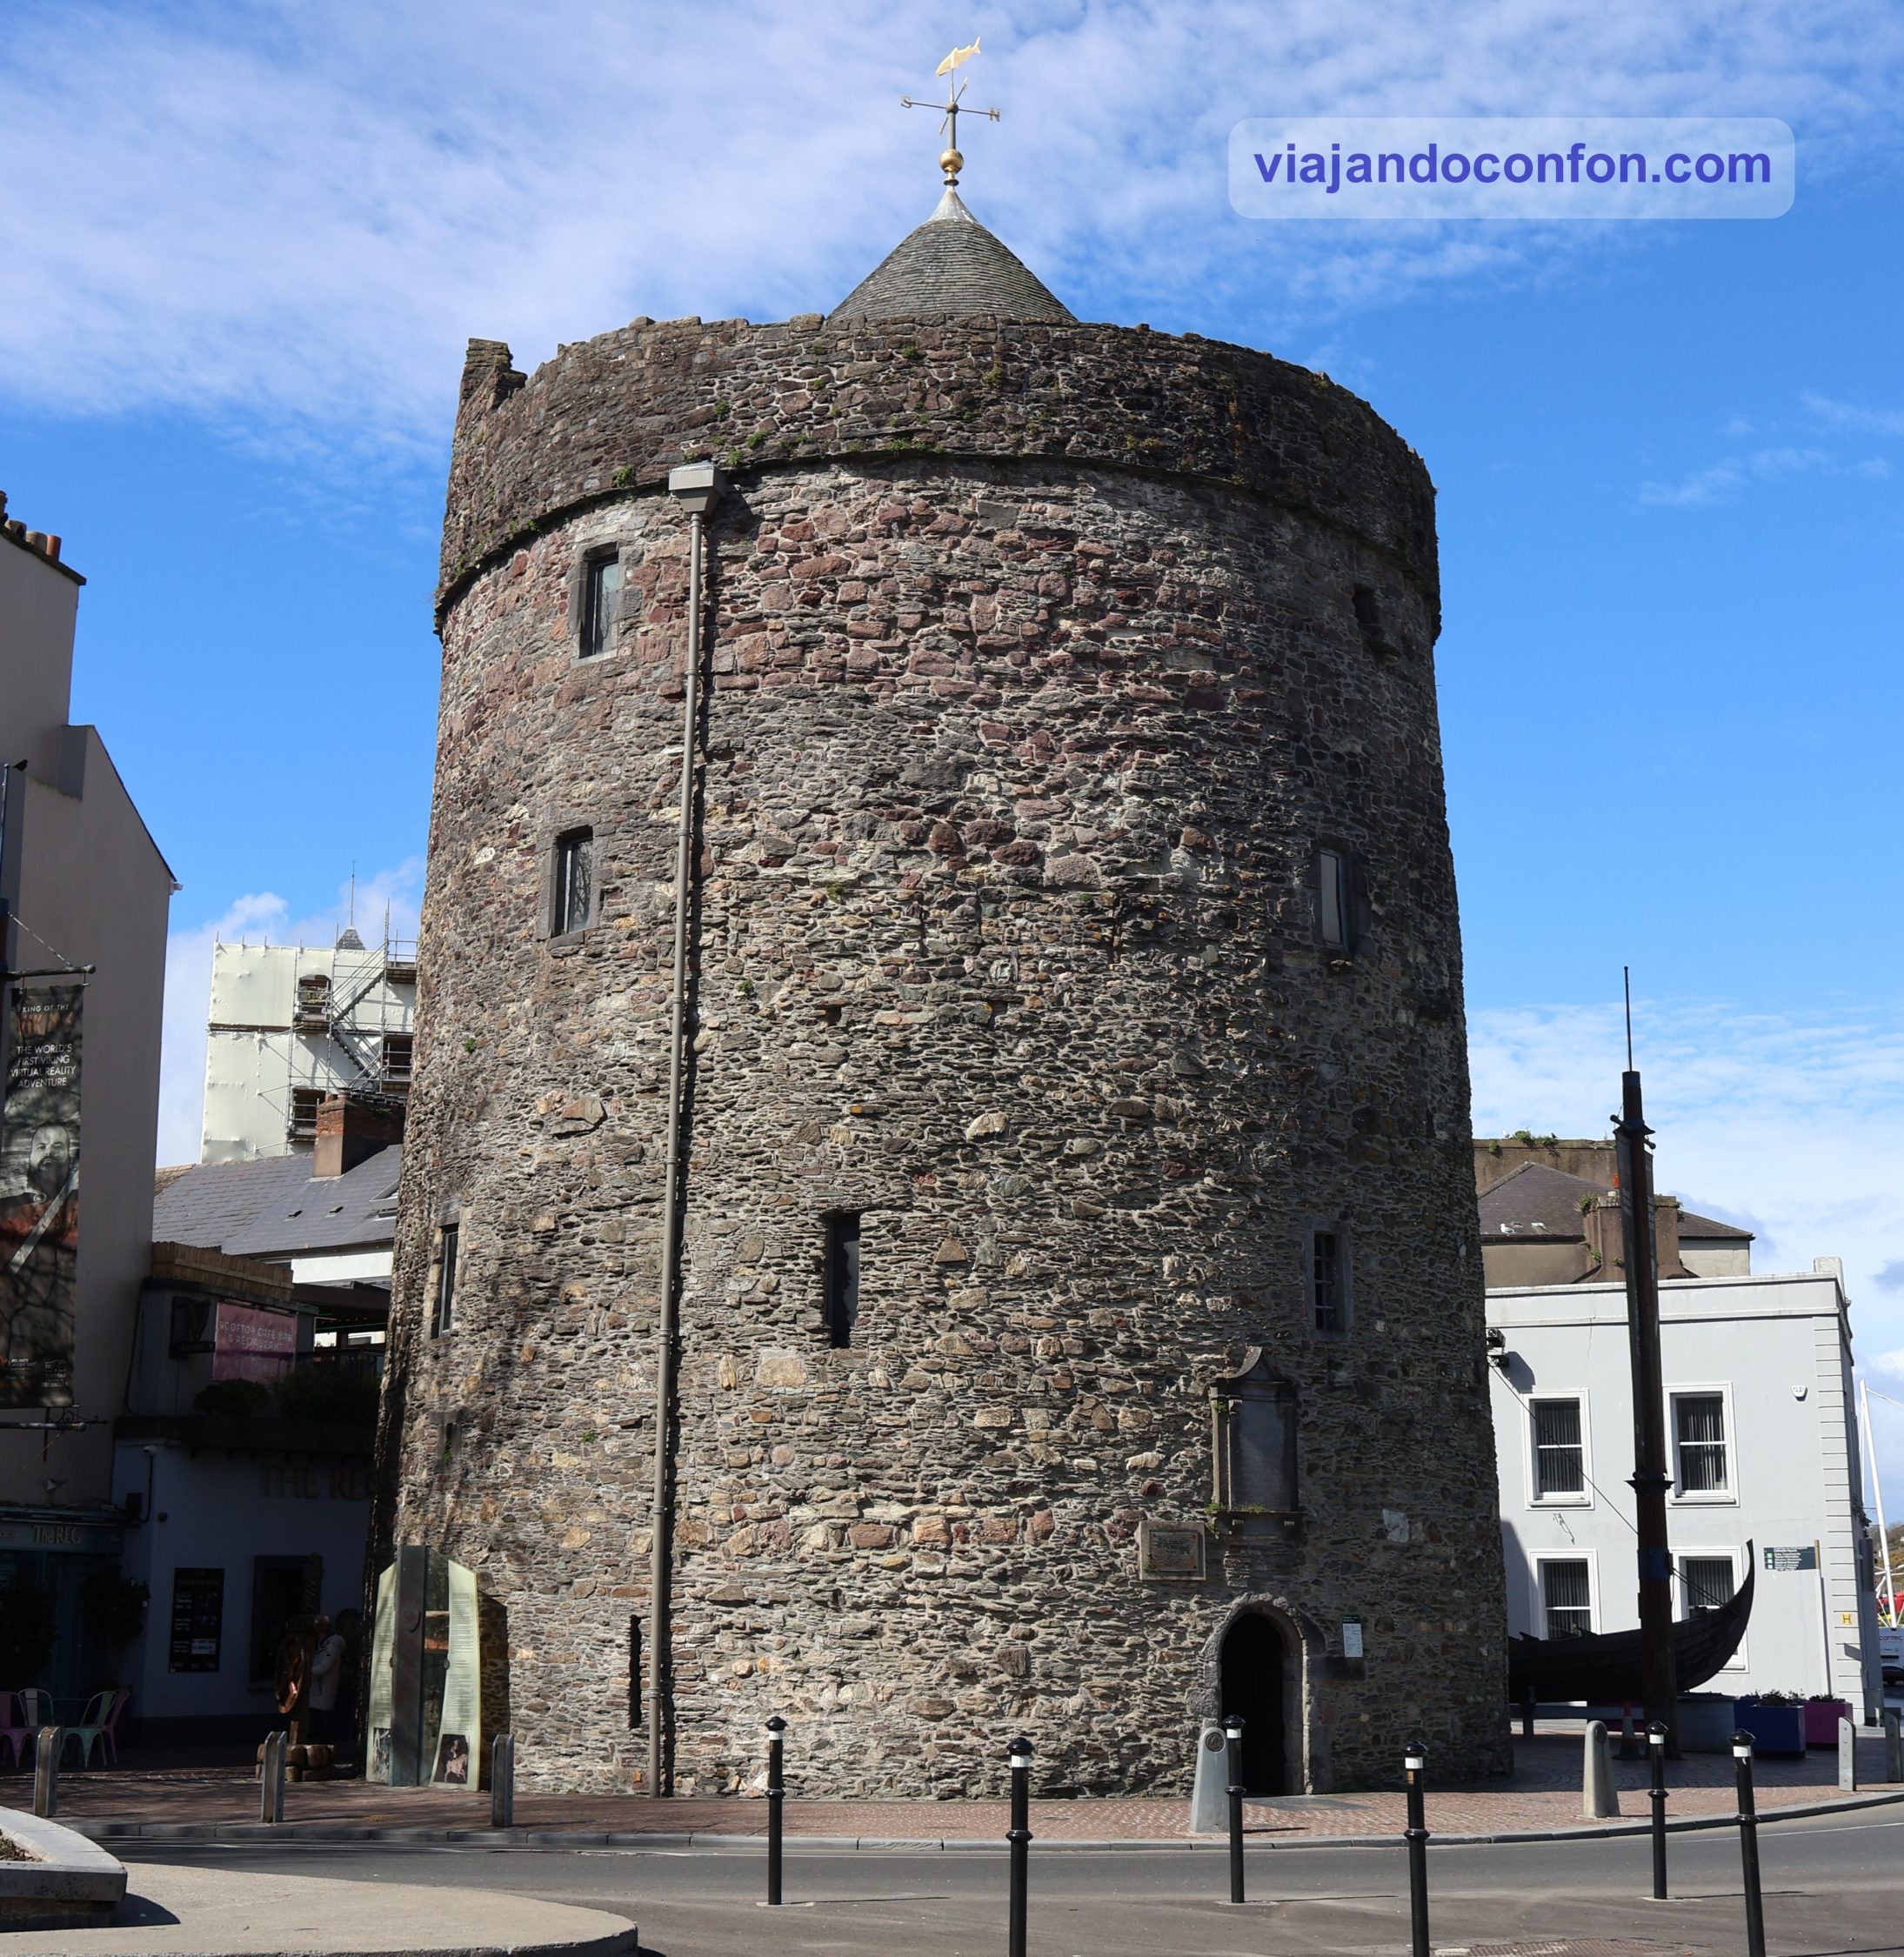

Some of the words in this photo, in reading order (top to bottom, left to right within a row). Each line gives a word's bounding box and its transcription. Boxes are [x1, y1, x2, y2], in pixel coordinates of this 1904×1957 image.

[17, 1045, 32, 1055] THE
[35, 1044, 72, 1053] WORLD'S
[17, 1056, 38, 1065] FIRST
[40, 1054, 70, 1065] VIKING
[10, 1068, 43, 1078] VIRTUAL
[45, 1065, 77, 1076] REALITY
[18, 1078, 67, 1088] ADVENTURE
[219, 1321, 255, 1333] ROOFTOP
[227, 1333, 233, 1343] &
[236, 1336, 284, 1351] RESTAURANT
[259, 1462, 320, 1499] THE
[34, 1525, 55, 1544] The
